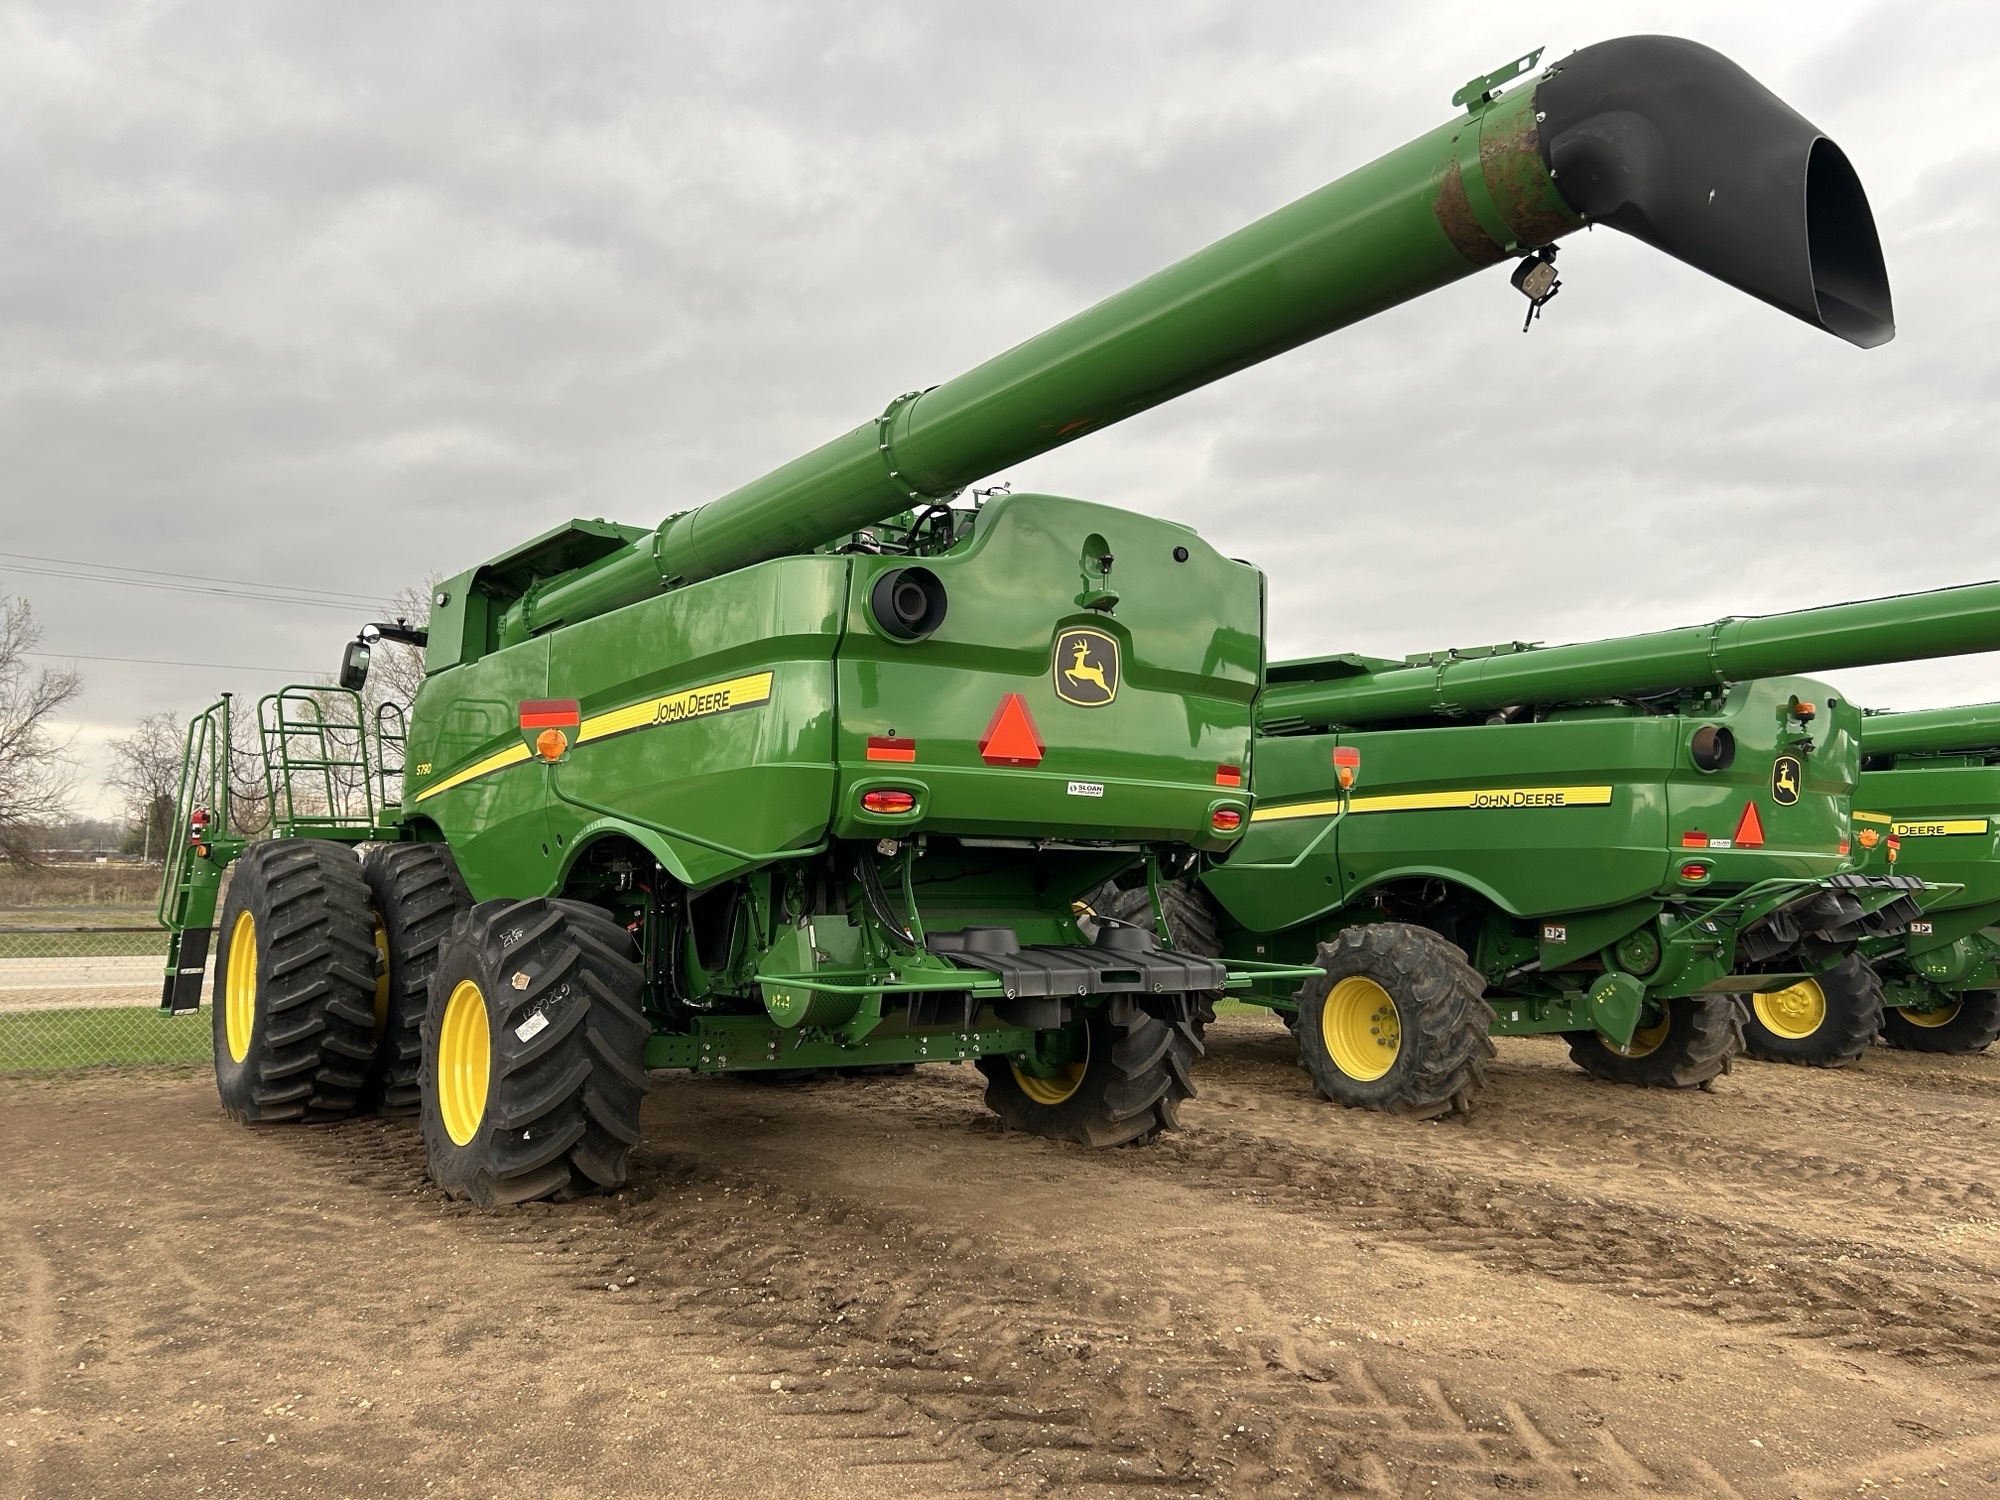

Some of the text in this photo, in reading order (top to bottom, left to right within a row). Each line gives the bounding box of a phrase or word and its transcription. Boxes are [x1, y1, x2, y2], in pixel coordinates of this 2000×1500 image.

[653, 689, 731, 722] JOHN DEERE
[416, 762, 432, 776] S790
[1078, 784, 1102, 792] SLOAN
[1469, 792, 1565, 807] JOHN DEERE
[1898, 824, 1945, 835] DEERE
